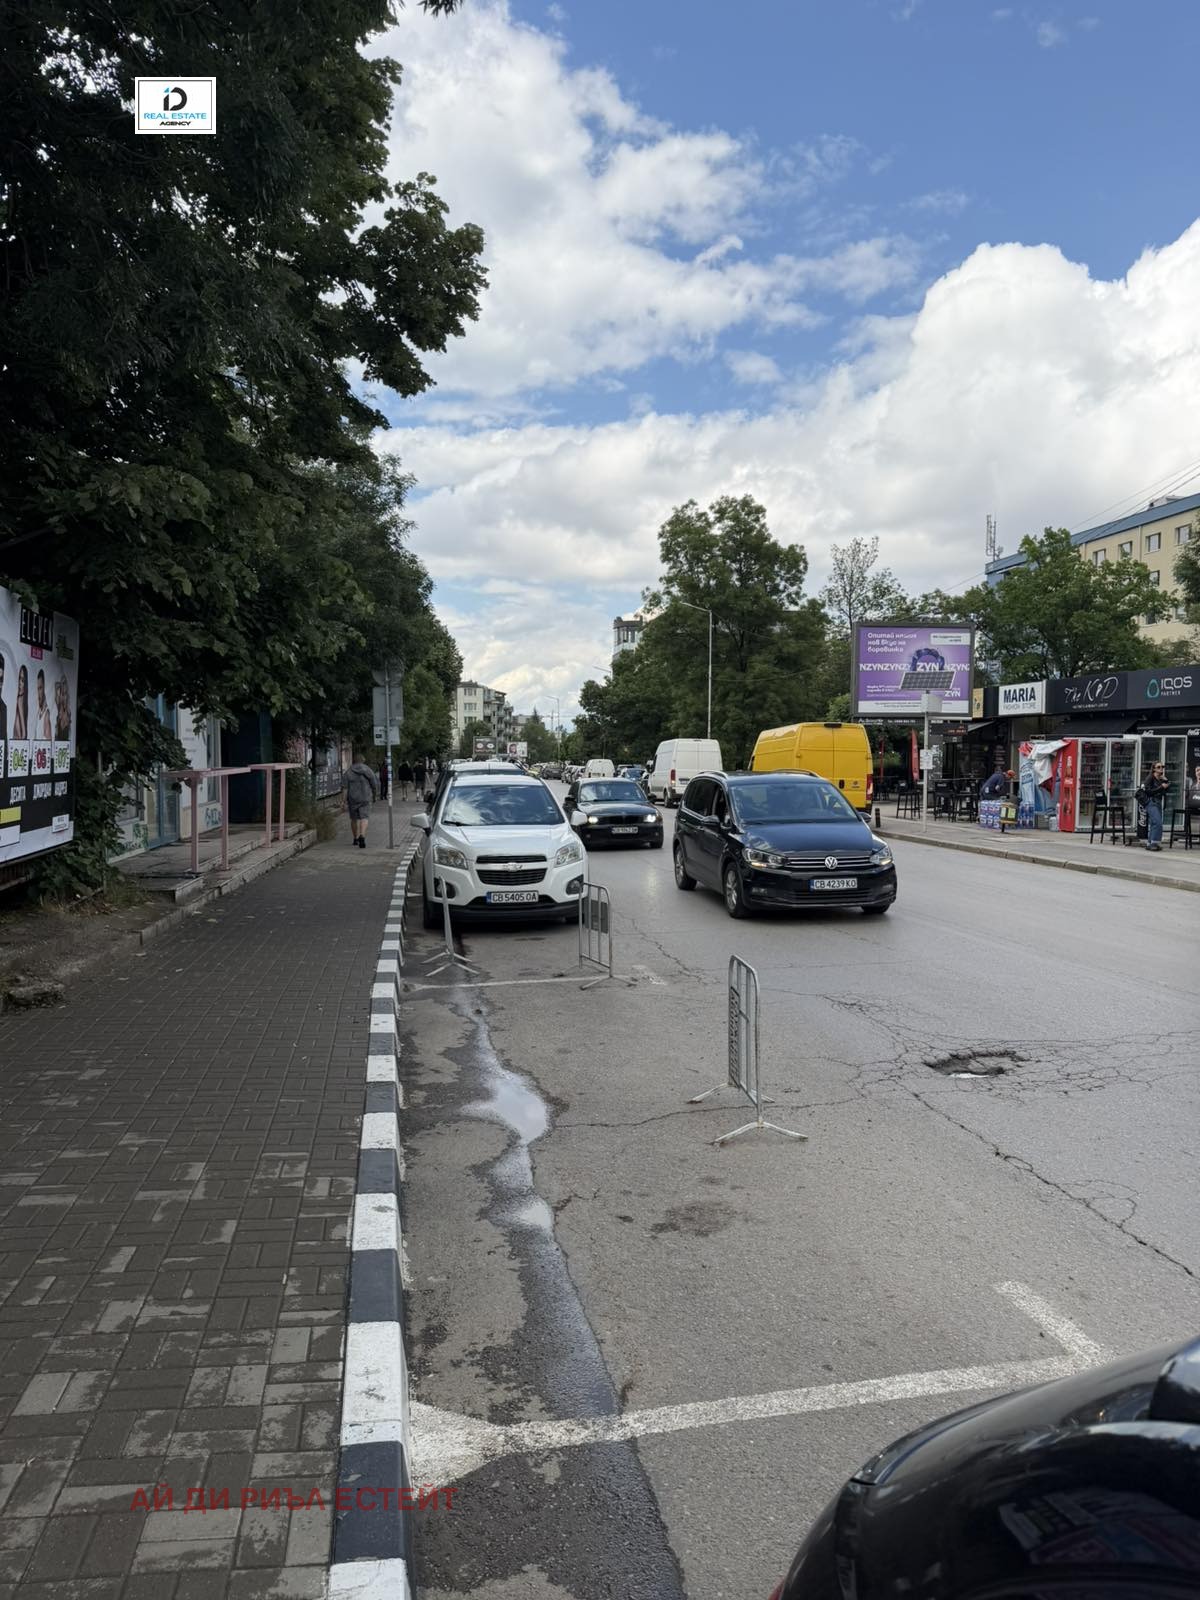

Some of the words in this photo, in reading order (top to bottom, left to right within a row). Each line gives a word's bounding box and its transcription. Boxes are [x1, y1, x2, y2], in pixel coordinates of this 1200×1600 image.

[917, 662, 944, 672] ZYN
[1160, 676, 1193, 691] IQOS
[944, 690, 961, 698] ZYN
[1004, 687, 1036, 704] MARIA
[1064, 687, 1081, 703] The
[815, 880, 826, 889] CB
[826, 879, 845, 889] 4239
[846, 879, 857, 888] KO
[492, 893, 504, 902] CB
[504, 893, 525, 902] 5405
